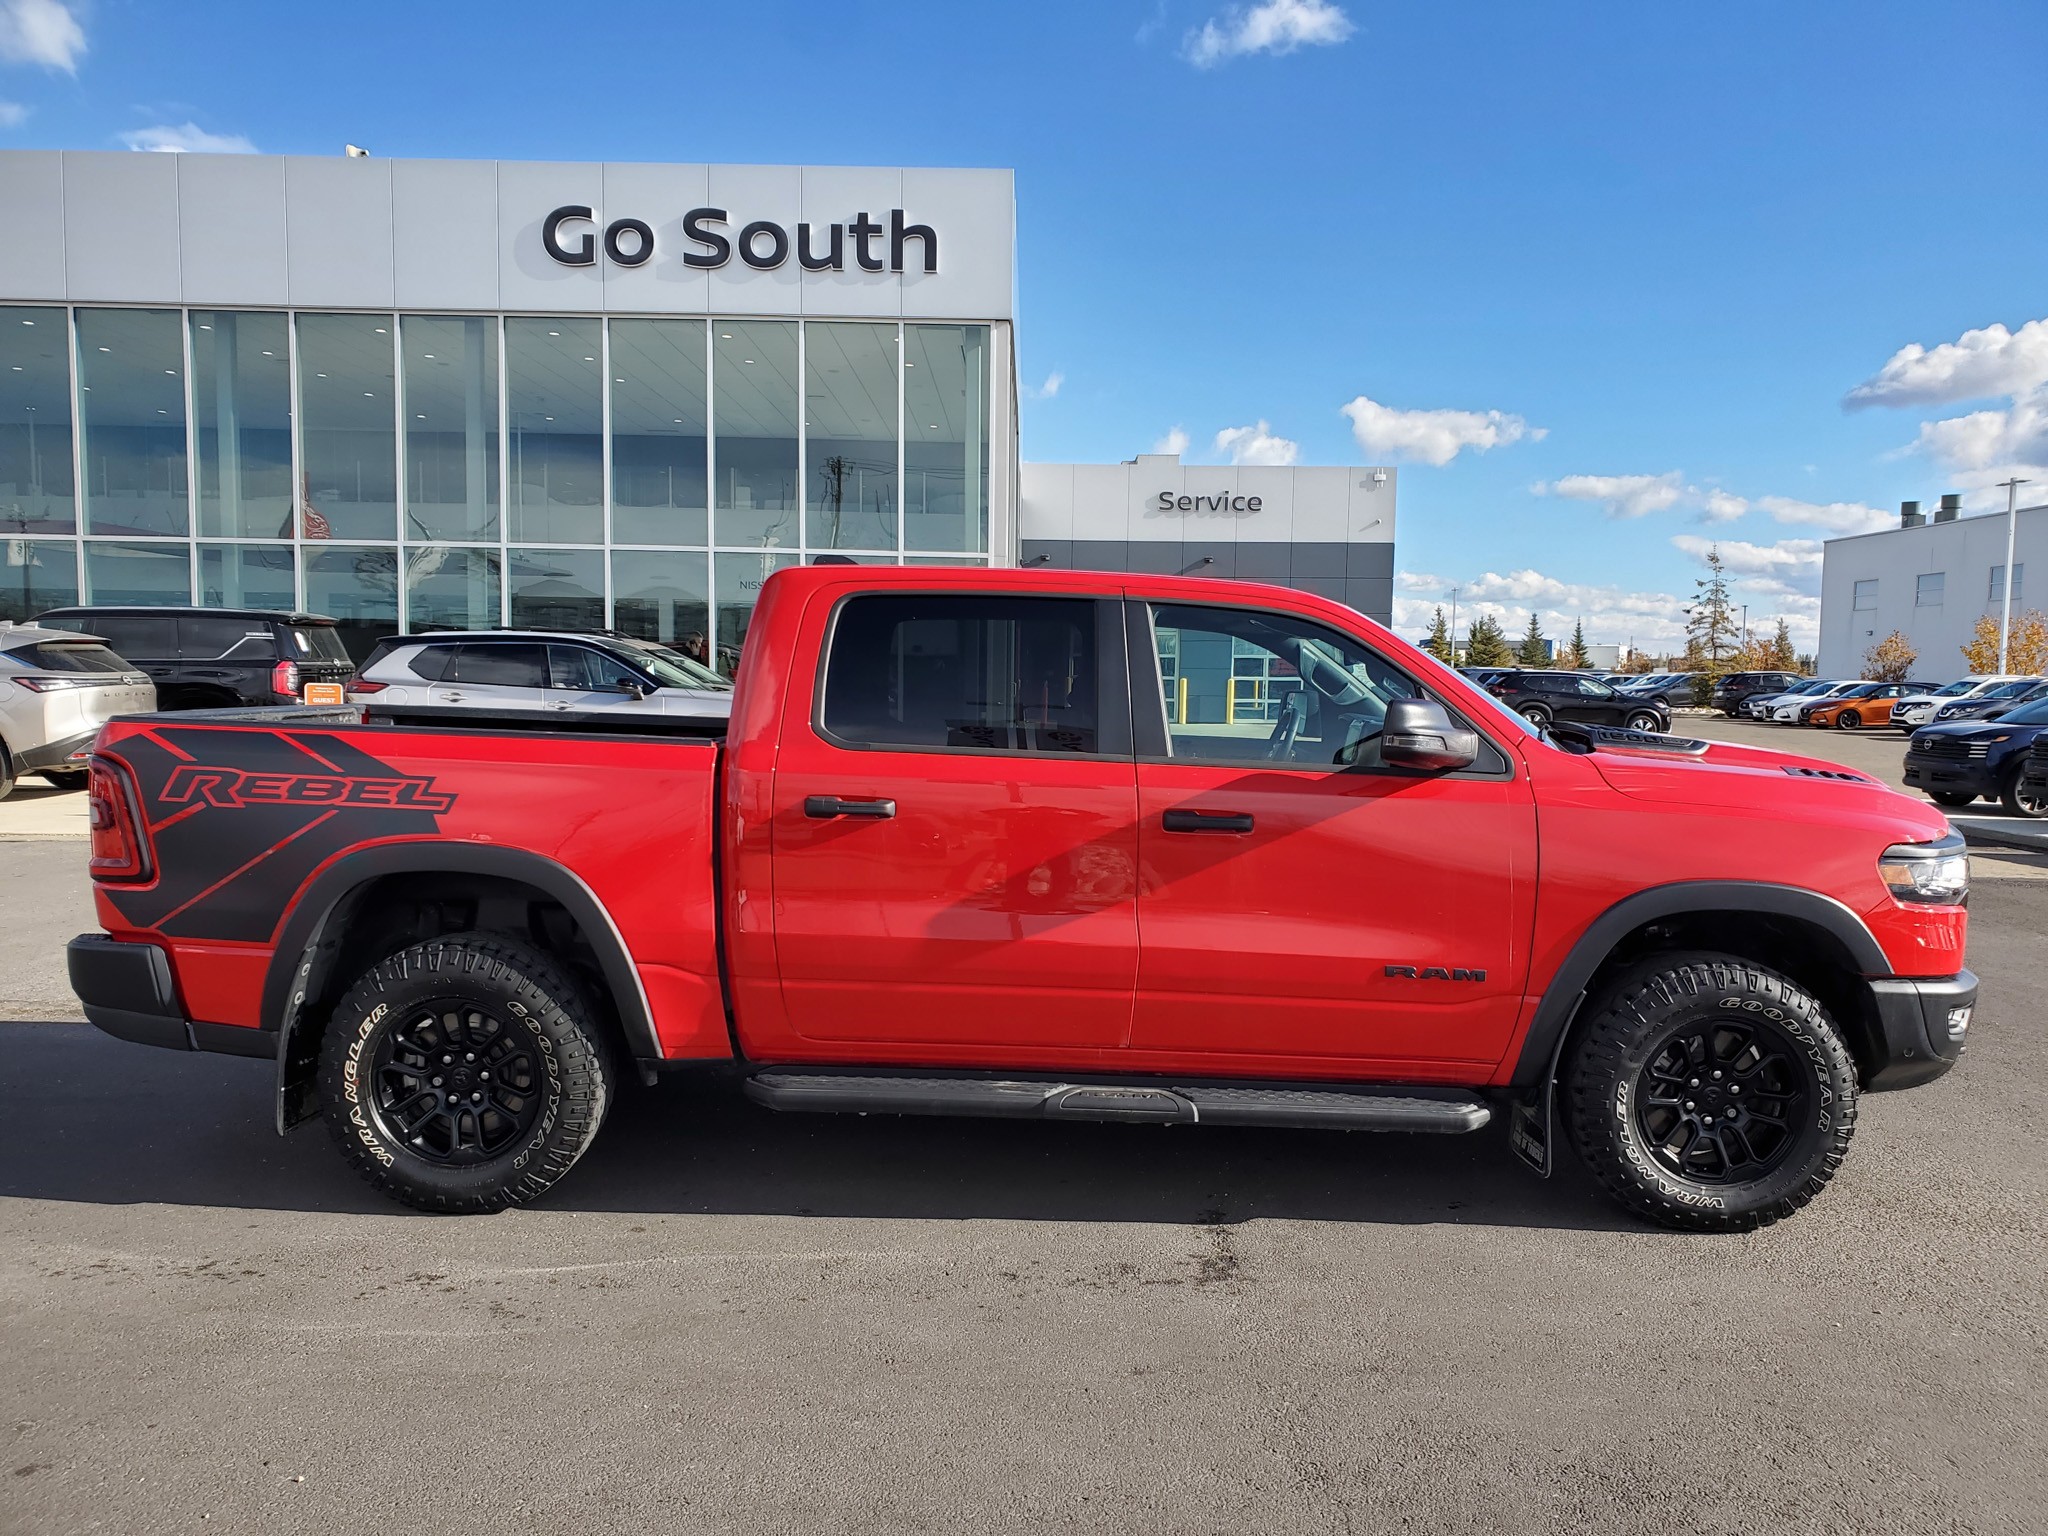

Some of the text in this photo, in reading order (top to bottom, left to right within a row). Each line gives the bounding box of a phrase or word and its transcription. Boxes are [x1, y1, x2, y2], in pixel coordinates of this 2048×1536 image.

[542, 205, 938, 274] Go South
[1158, 490, 1263, 513] Service
[157, 765, 459, 811] REBEL
[1385, 965, 1487, 982] RAM
[343, 1003, 395, 1168] WRANGLER
[507, 1001, 562, 1169] GOODYEAR
[1719, 997, 1833, 1133] GOODYEAR
[1617, 1080, 1725, 1209] WRANGLER
